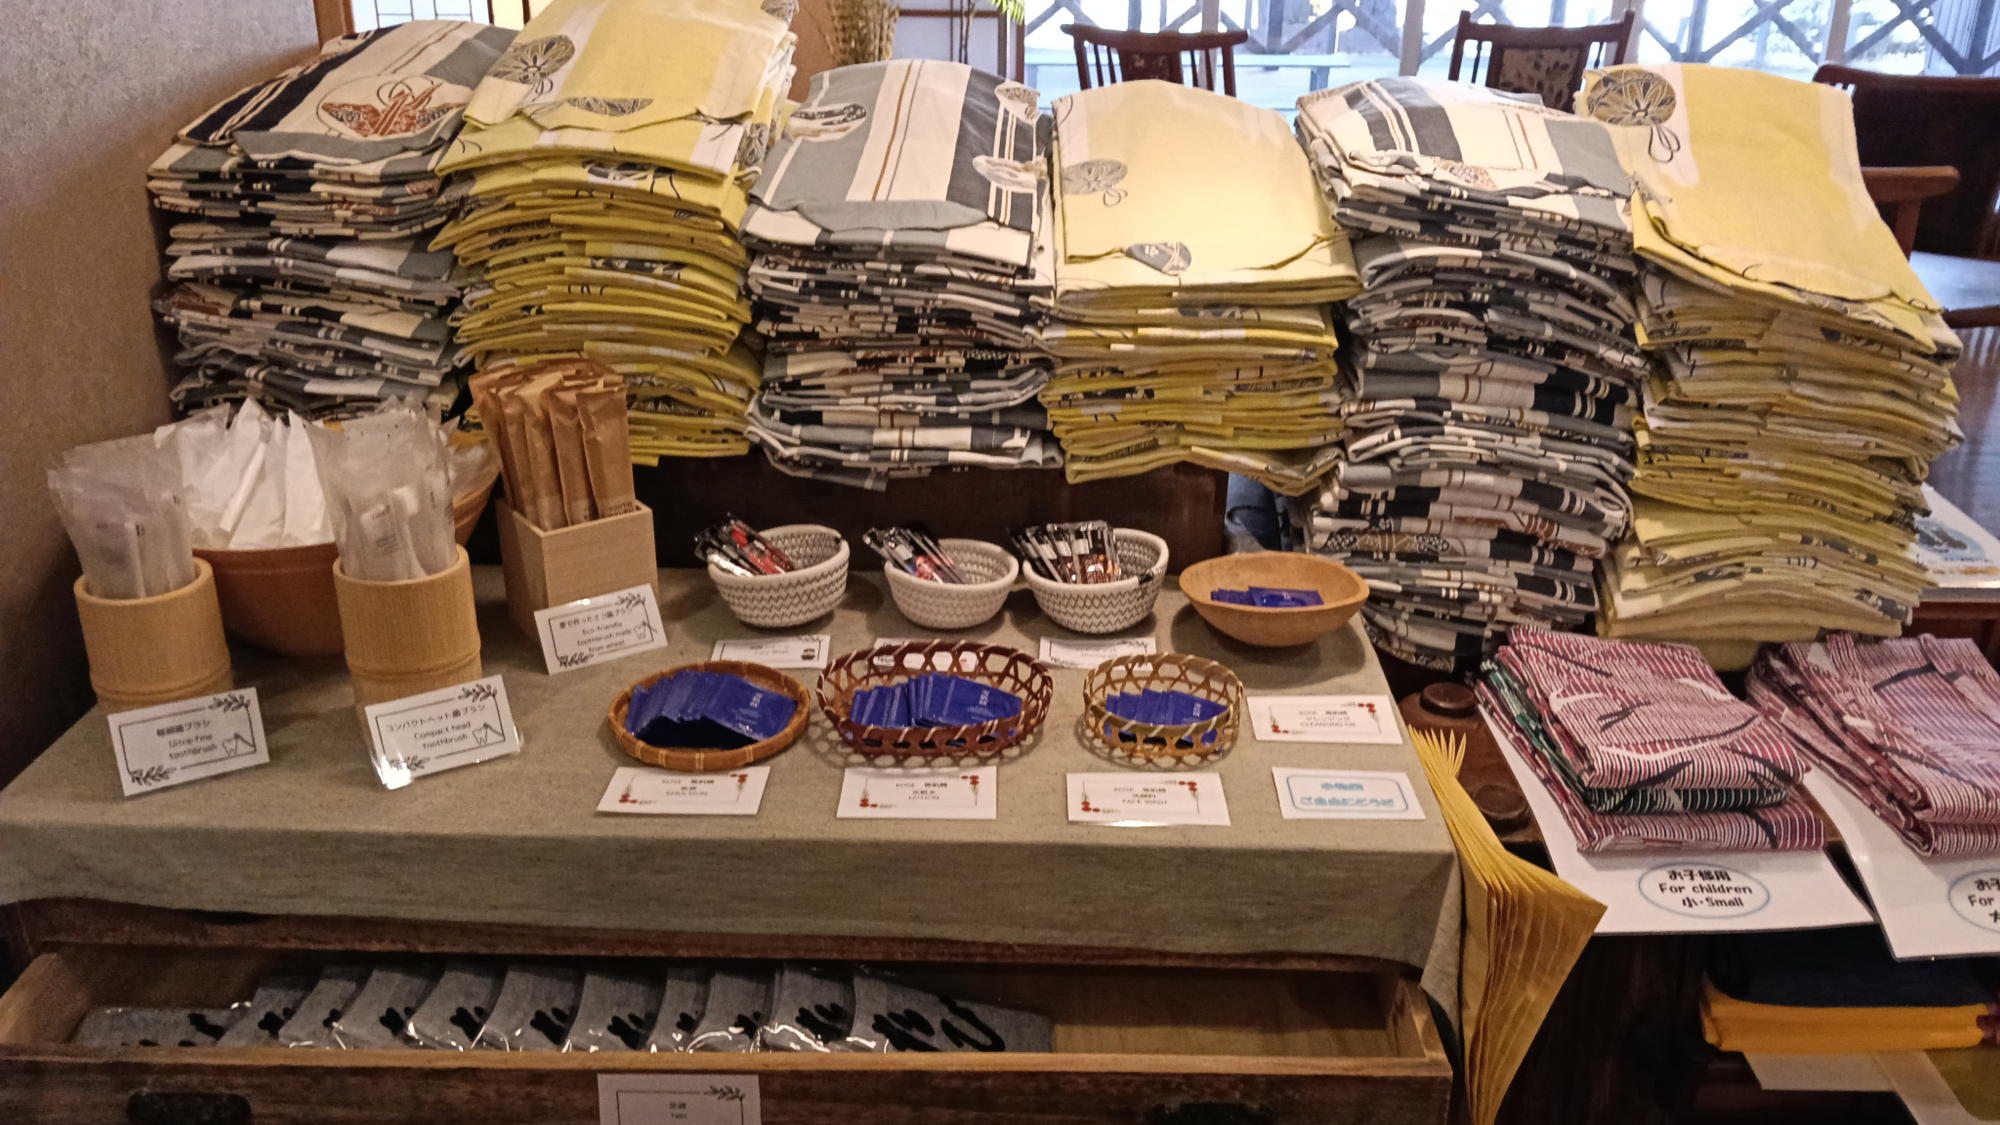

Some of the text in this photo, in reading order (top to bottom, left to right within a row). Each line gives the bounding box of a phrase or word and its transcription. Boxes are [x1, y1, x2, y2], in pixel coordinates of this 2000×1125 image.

[414, 721, 471, 740] Compact head
[422, 733, 469, 750] toothbrush
[168, 743, 218, 761] toothbrush
[1658, 883, 1753, 895] For children
[1967, 894, 1996, 908] For
